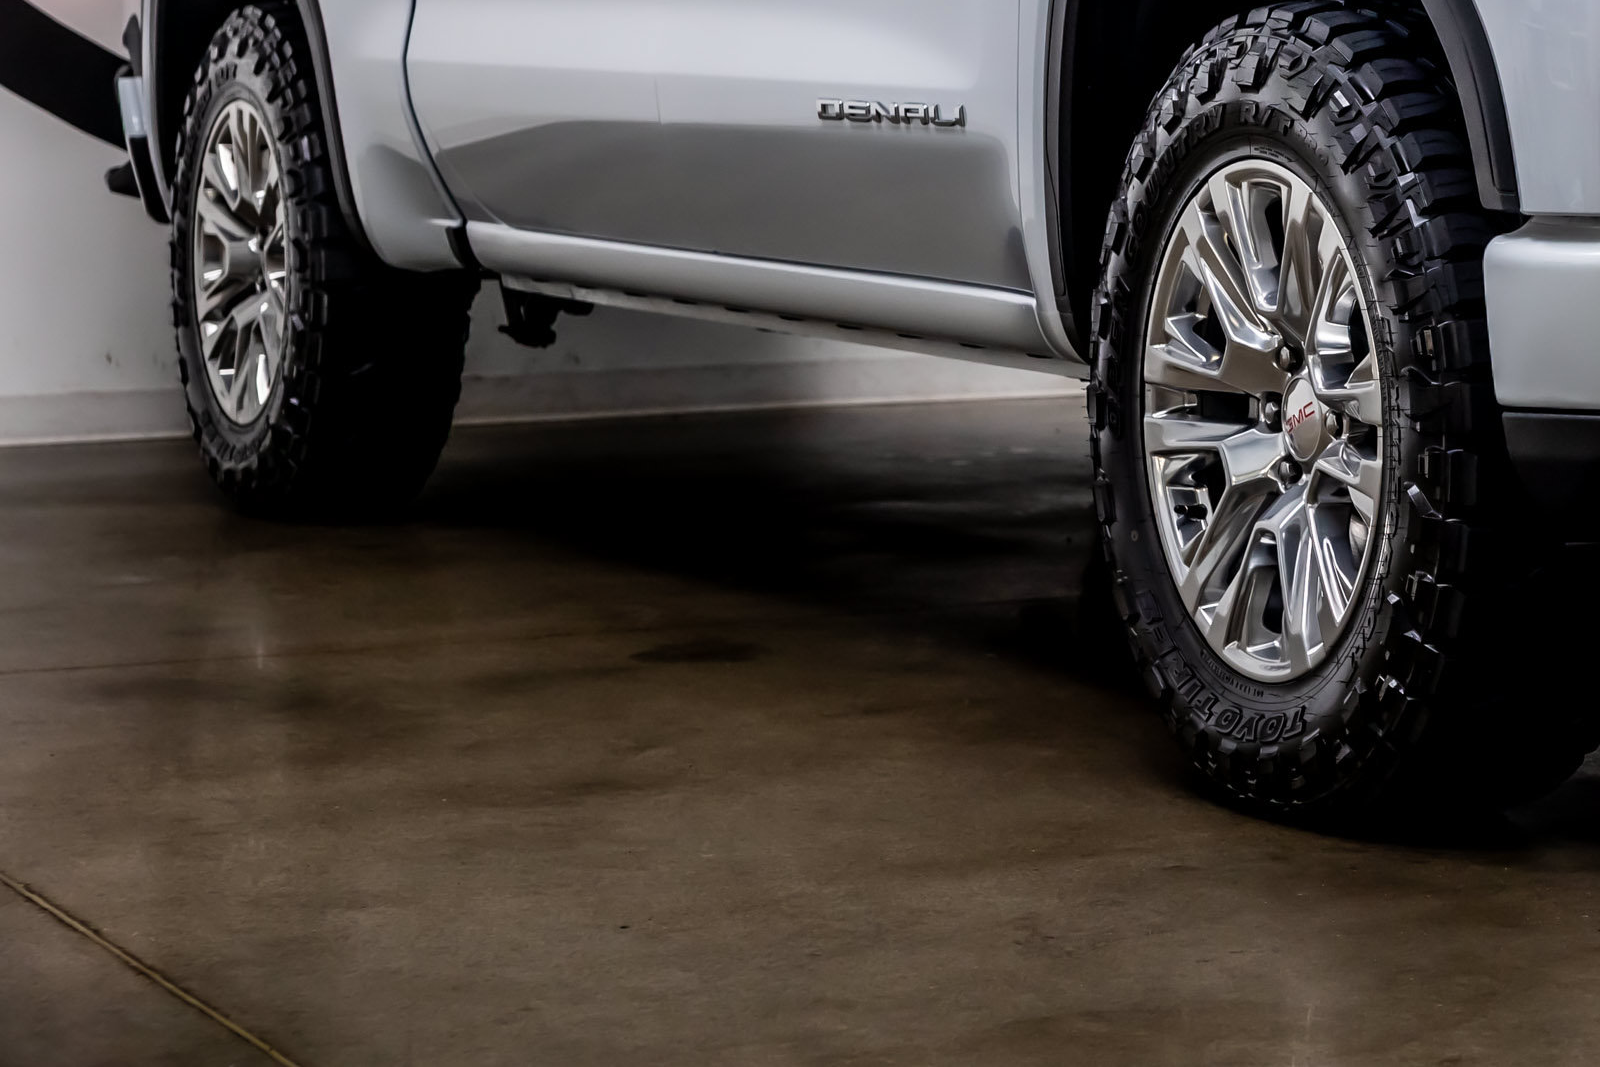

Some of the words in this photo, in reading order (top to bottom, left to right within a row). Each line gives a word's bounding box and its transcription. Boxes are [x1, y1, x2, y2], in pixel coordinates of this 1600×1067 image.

[816, 97, 967, 127] DENALI
[1124, 102, 1227, 266] COUNTRY
[1285, 401, 1315, 434] GMC
[1208, 704, 1307, 745] TOYO
